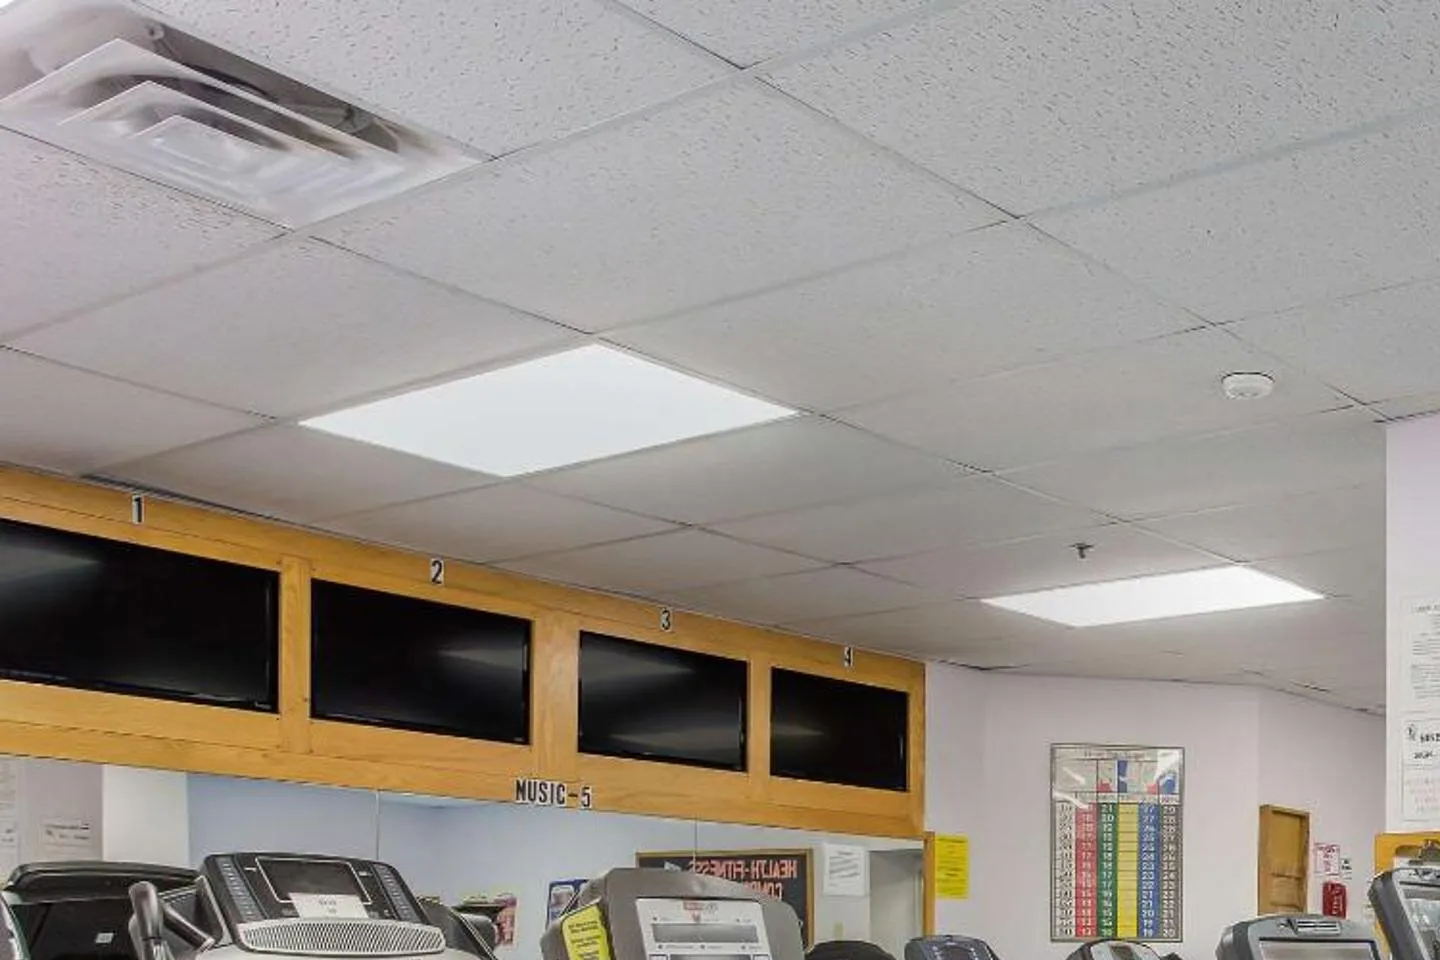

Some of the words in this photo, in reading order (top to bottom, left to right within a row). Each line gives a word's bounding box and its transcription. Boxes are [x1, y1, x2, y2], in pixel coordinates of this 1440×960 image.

[132, 496, 143, 524] 1
[431, 560, 445, 584] 2
[661, 608, 671, 631] 3
